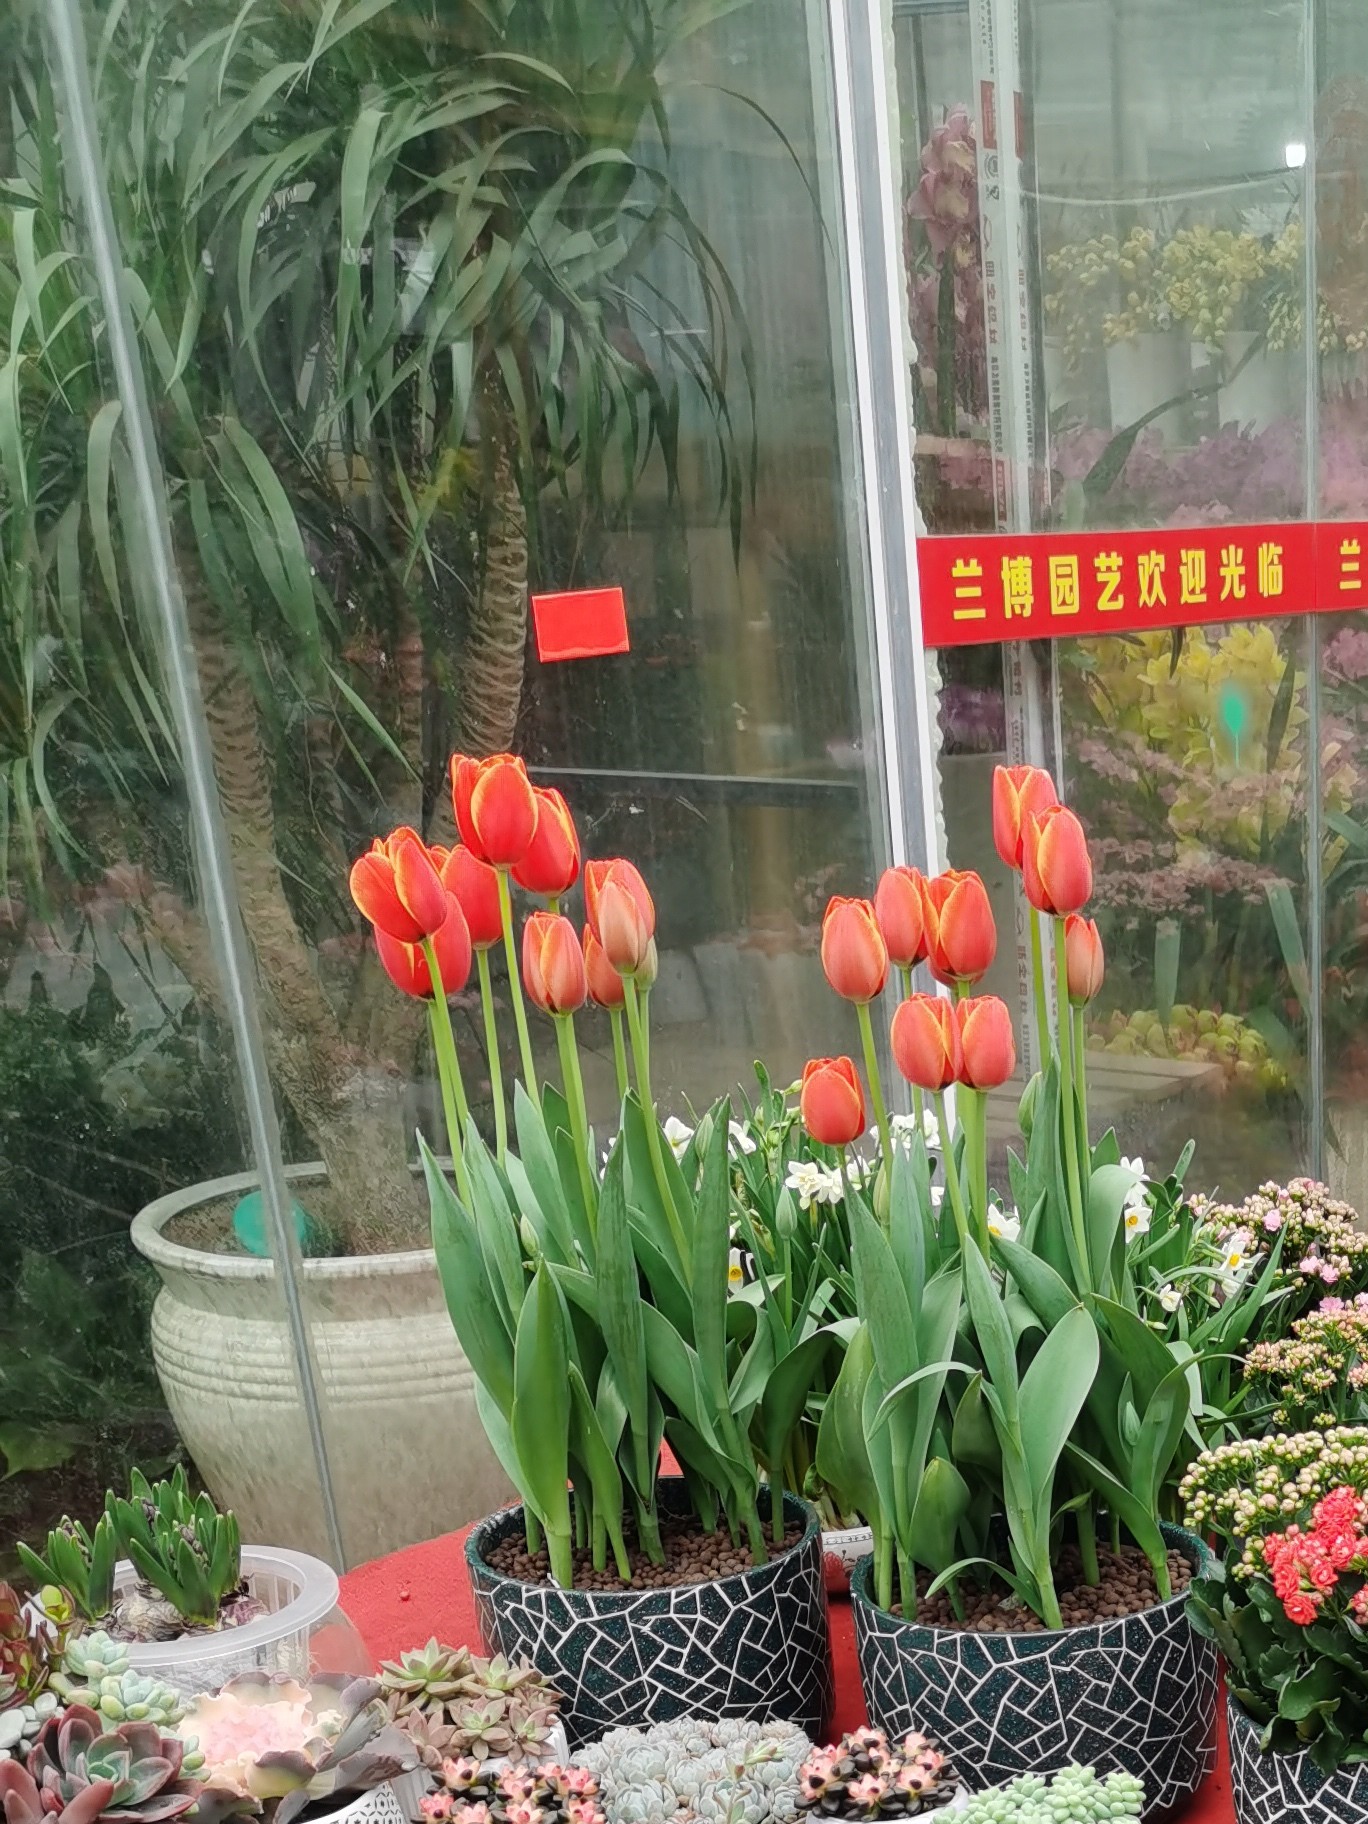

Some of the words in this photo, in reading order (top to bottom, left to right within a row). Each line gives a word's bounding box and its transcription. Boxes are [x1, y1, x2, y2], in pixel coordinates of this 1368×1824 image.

[951, 543, 1284, 621] 兰博园艺欢迎光临
